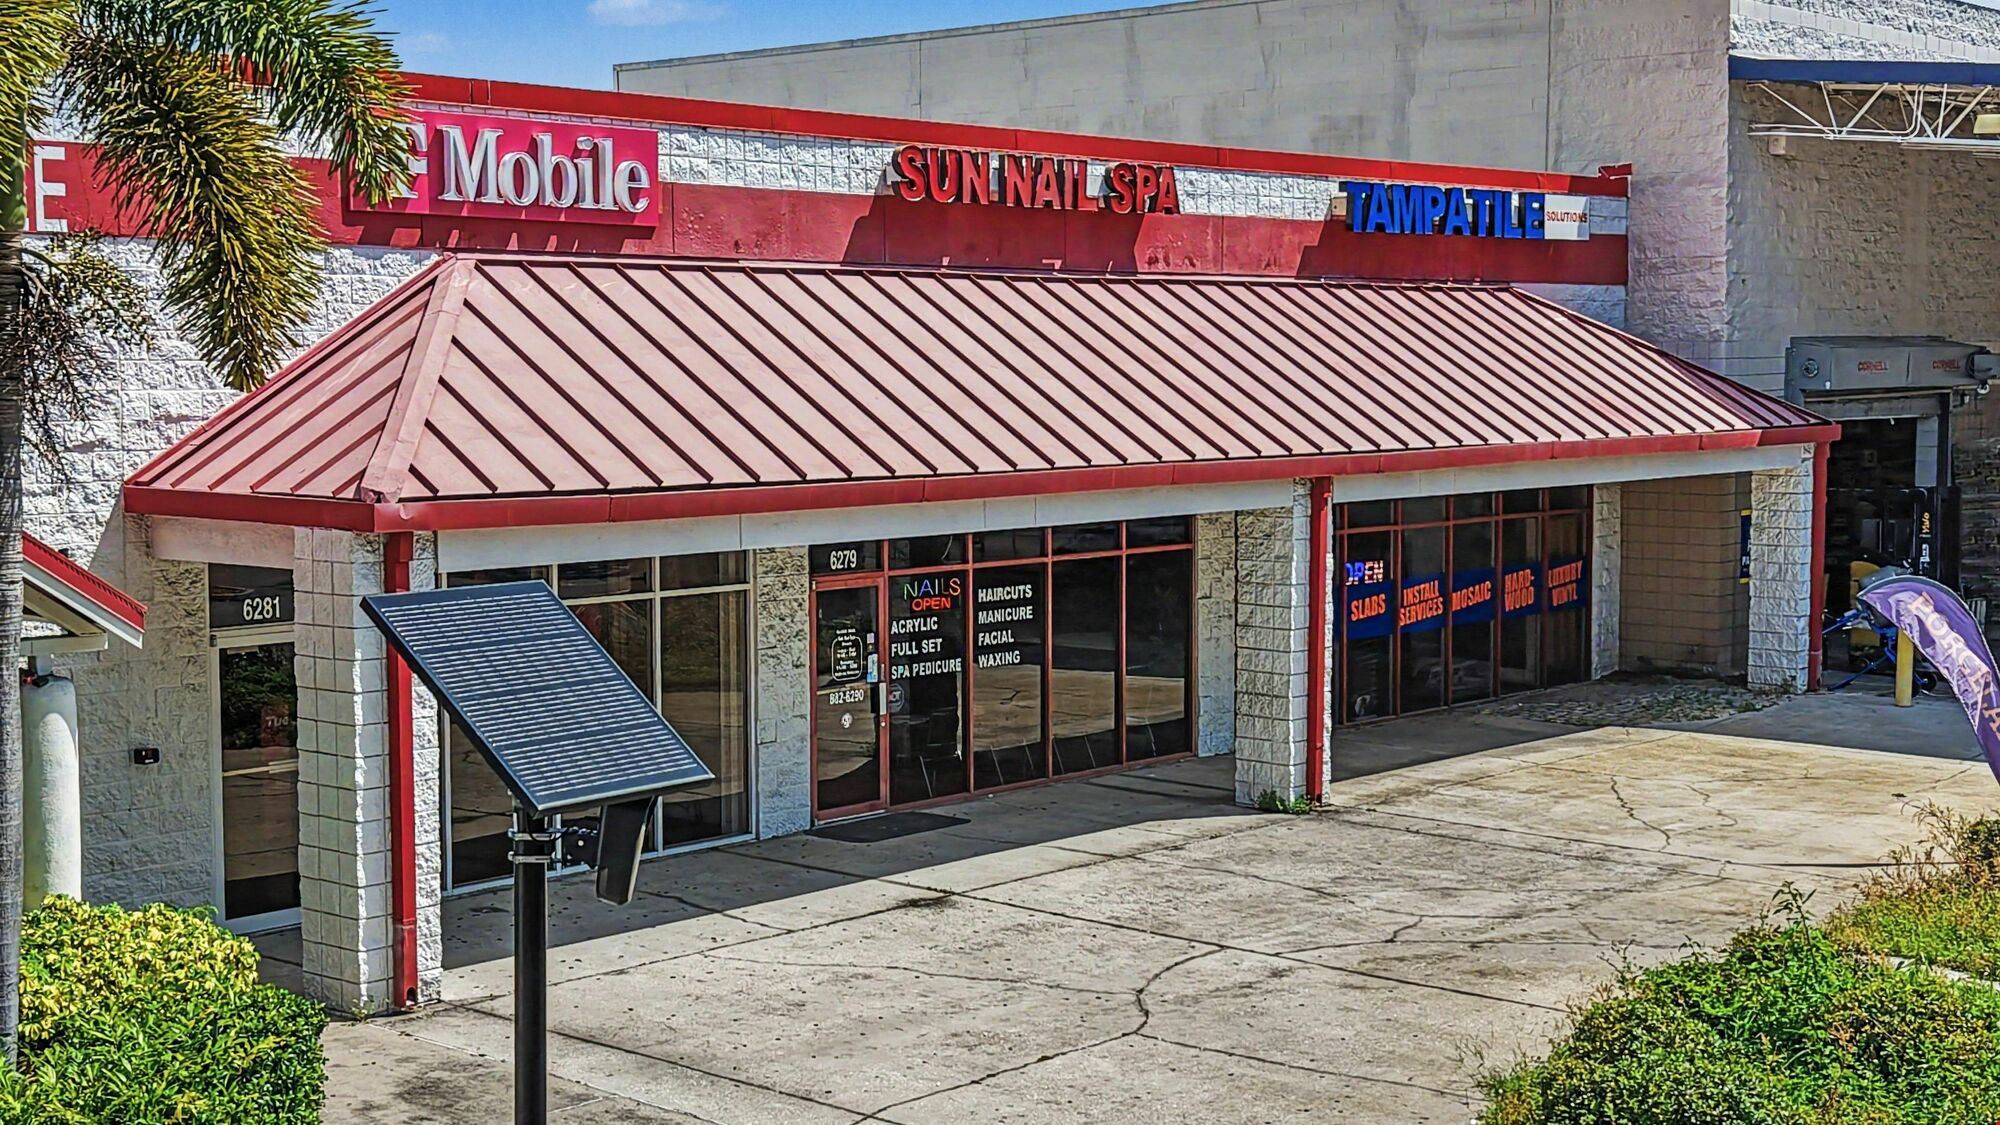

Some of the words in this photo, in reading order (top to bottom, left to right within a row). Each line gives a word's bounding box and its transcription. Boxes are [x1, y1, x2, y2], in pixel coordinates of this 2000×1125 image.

[893, 144, 990, 205] SUN
[1002, 153, 1099, 211] NAIL
[1107, 161, 1181, 215] SPA
[1546, 211, 1588, 223] SOLUTIONS
[829, 549, 857, 570] 6279
[1345, 560, 1384, 586] OPEN
[1548, 560, 1583, 588] LUXURY
[903, 577, 961, 600] NAILS
[977, 584, 1033, 603] HAIRCUTS
[1403, 580, 1439, 606] INSTALL
[1452, 580, 1492, 612] MOSAIC
[1504, 586, 1535, 612] WOOD
[243, 596, 281, 621] 6281
[911, 597, 951, 612] OPEN
[977, 605, 1034, 624] MANICURE
[1350, 593, 1386, 621] SLABS
[1399, 597, 1444, 626] SERVICES
[890, 616, 939, 635] ACRYLIC
[891, 640, 919, 657] FULL
[921, 638, 943, 653] SET
[978, 629, 1015, 646] FACIAL
[891, 664, 910, 680] SPA
[912, 658, 962, 677] PEDICURE
[977, 650, 1021, 669] WAXING
